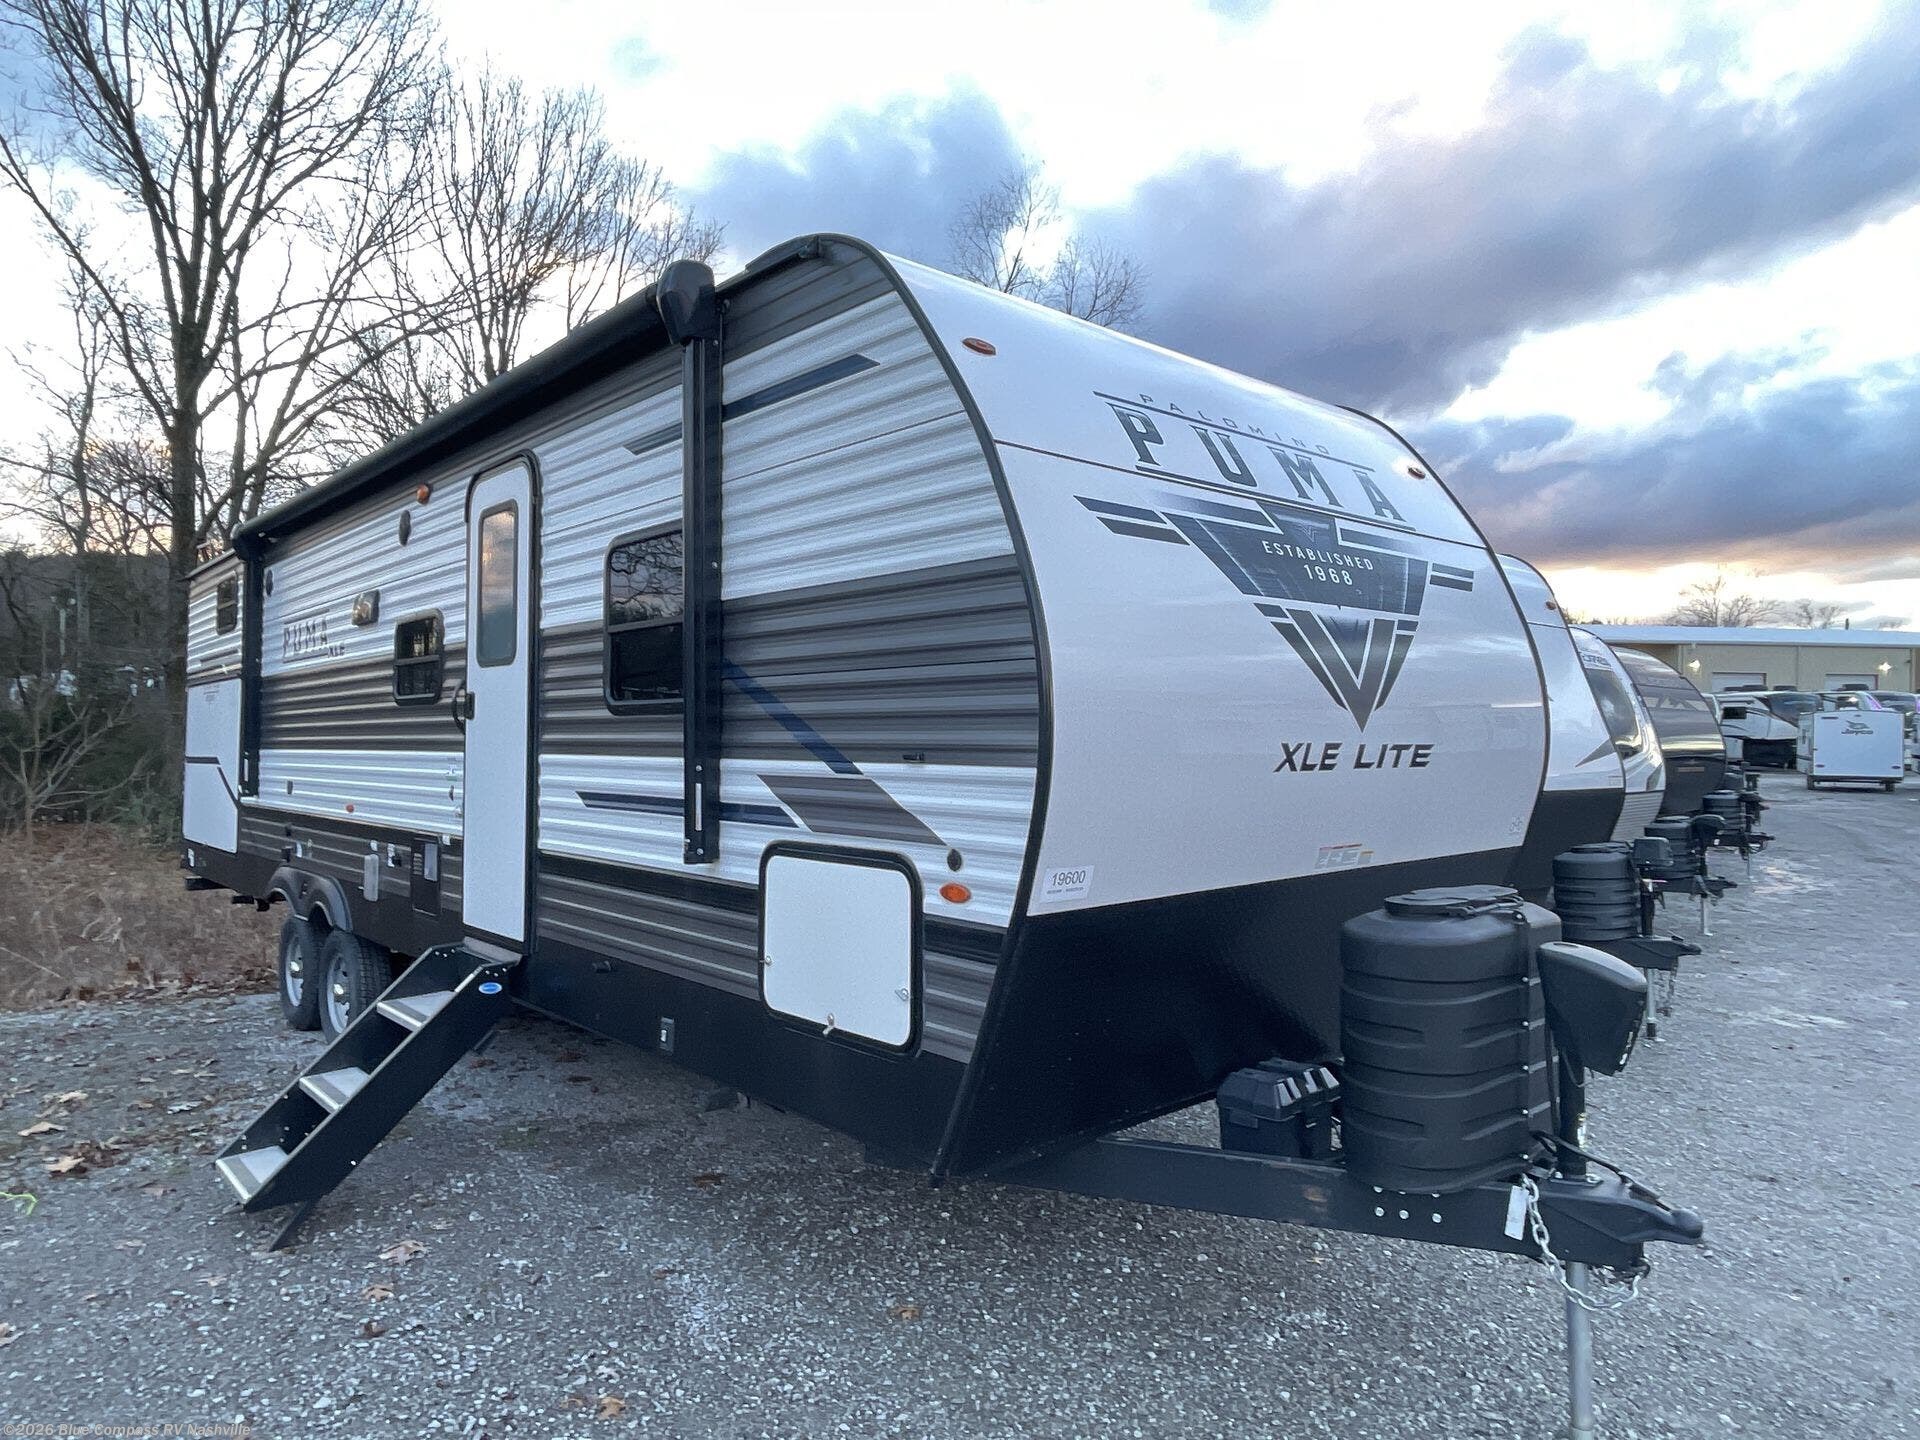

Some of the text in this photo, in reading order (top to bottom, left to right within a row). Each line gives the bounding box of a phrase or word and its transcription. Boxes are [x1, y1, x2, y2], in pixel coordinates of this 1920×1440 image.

[1140, 393, 1330, 455] PALOMINO
[1107, 402, 1408, 523] PUMA
[1261, 539, 1375, 572] ESTABLISHED
[1303, 564, 1354, 587] 1968
[283, 619, 328, 658] PUMA
[1273, 742, 1435, 772] XLE LITE
[1052, 870, 1086, 886] 19600
